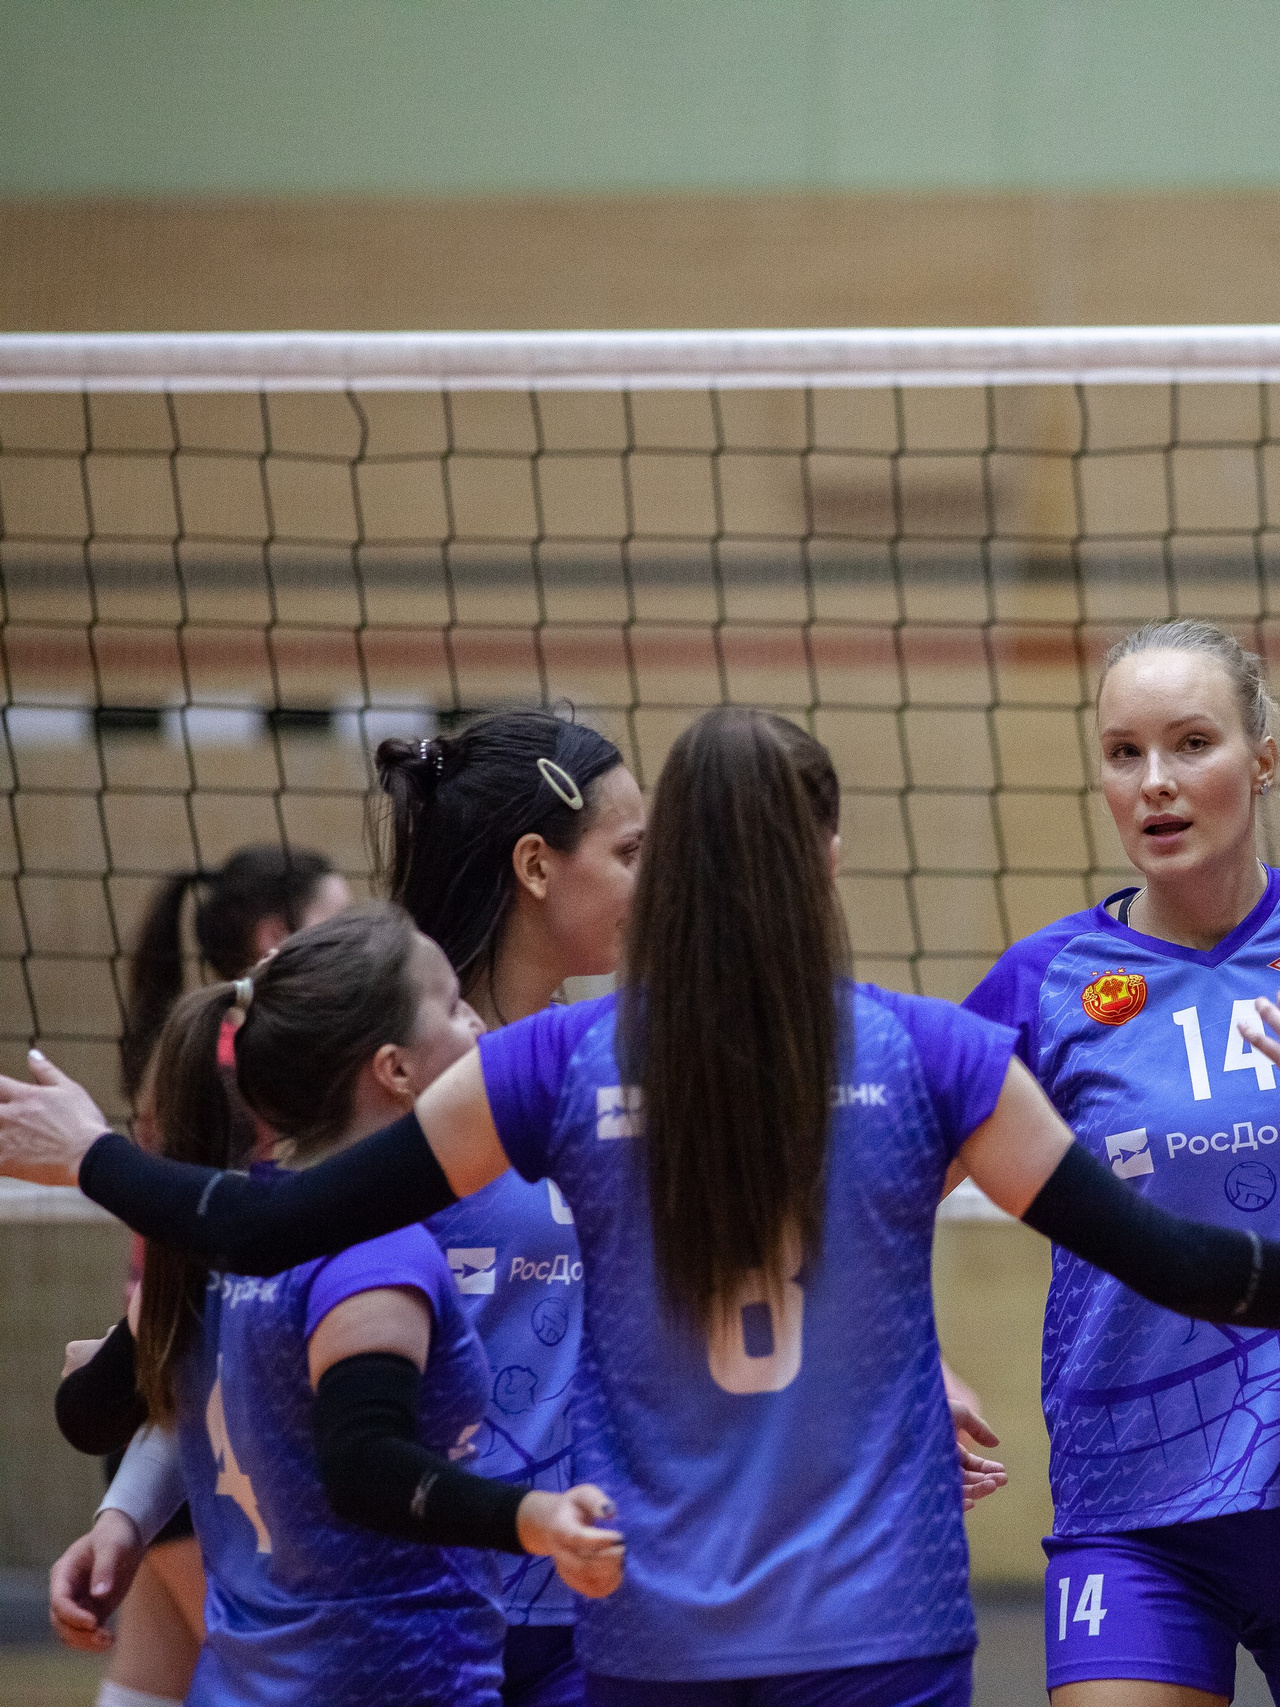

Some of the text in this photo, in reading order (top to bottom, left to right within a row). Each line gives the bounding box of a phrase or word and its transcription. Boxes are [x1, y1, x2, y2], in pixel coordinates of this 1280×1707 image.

[1172, 998, 1277, 1101] 14
[508, 1254, 584, 1286] РосДо
[1058, 1574, 1108, 1641] 14
